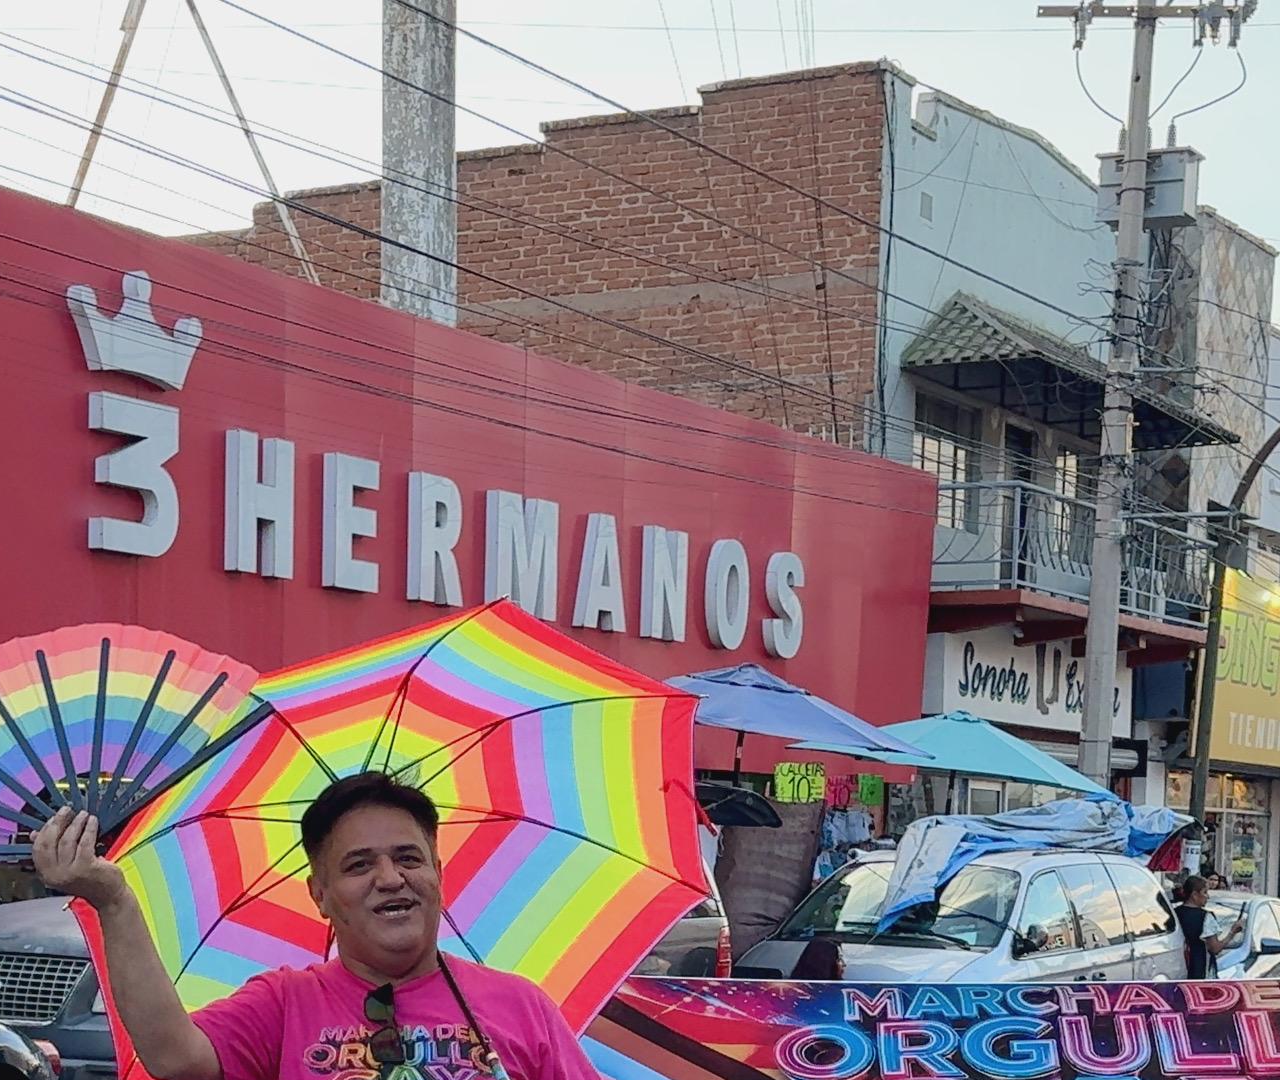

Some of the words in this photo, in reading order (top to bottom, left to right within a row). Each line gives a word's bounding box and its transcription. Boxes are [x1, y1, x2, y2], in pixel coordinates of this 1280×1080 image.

[87, 391, 180, 558] 3
[223, 427, 806, 661] HERMANOS
[958, 640, 1031, 706] Sonora
[787, 776, 811, 804] 10
[841, 982, 1163, 1021] MARCHA
